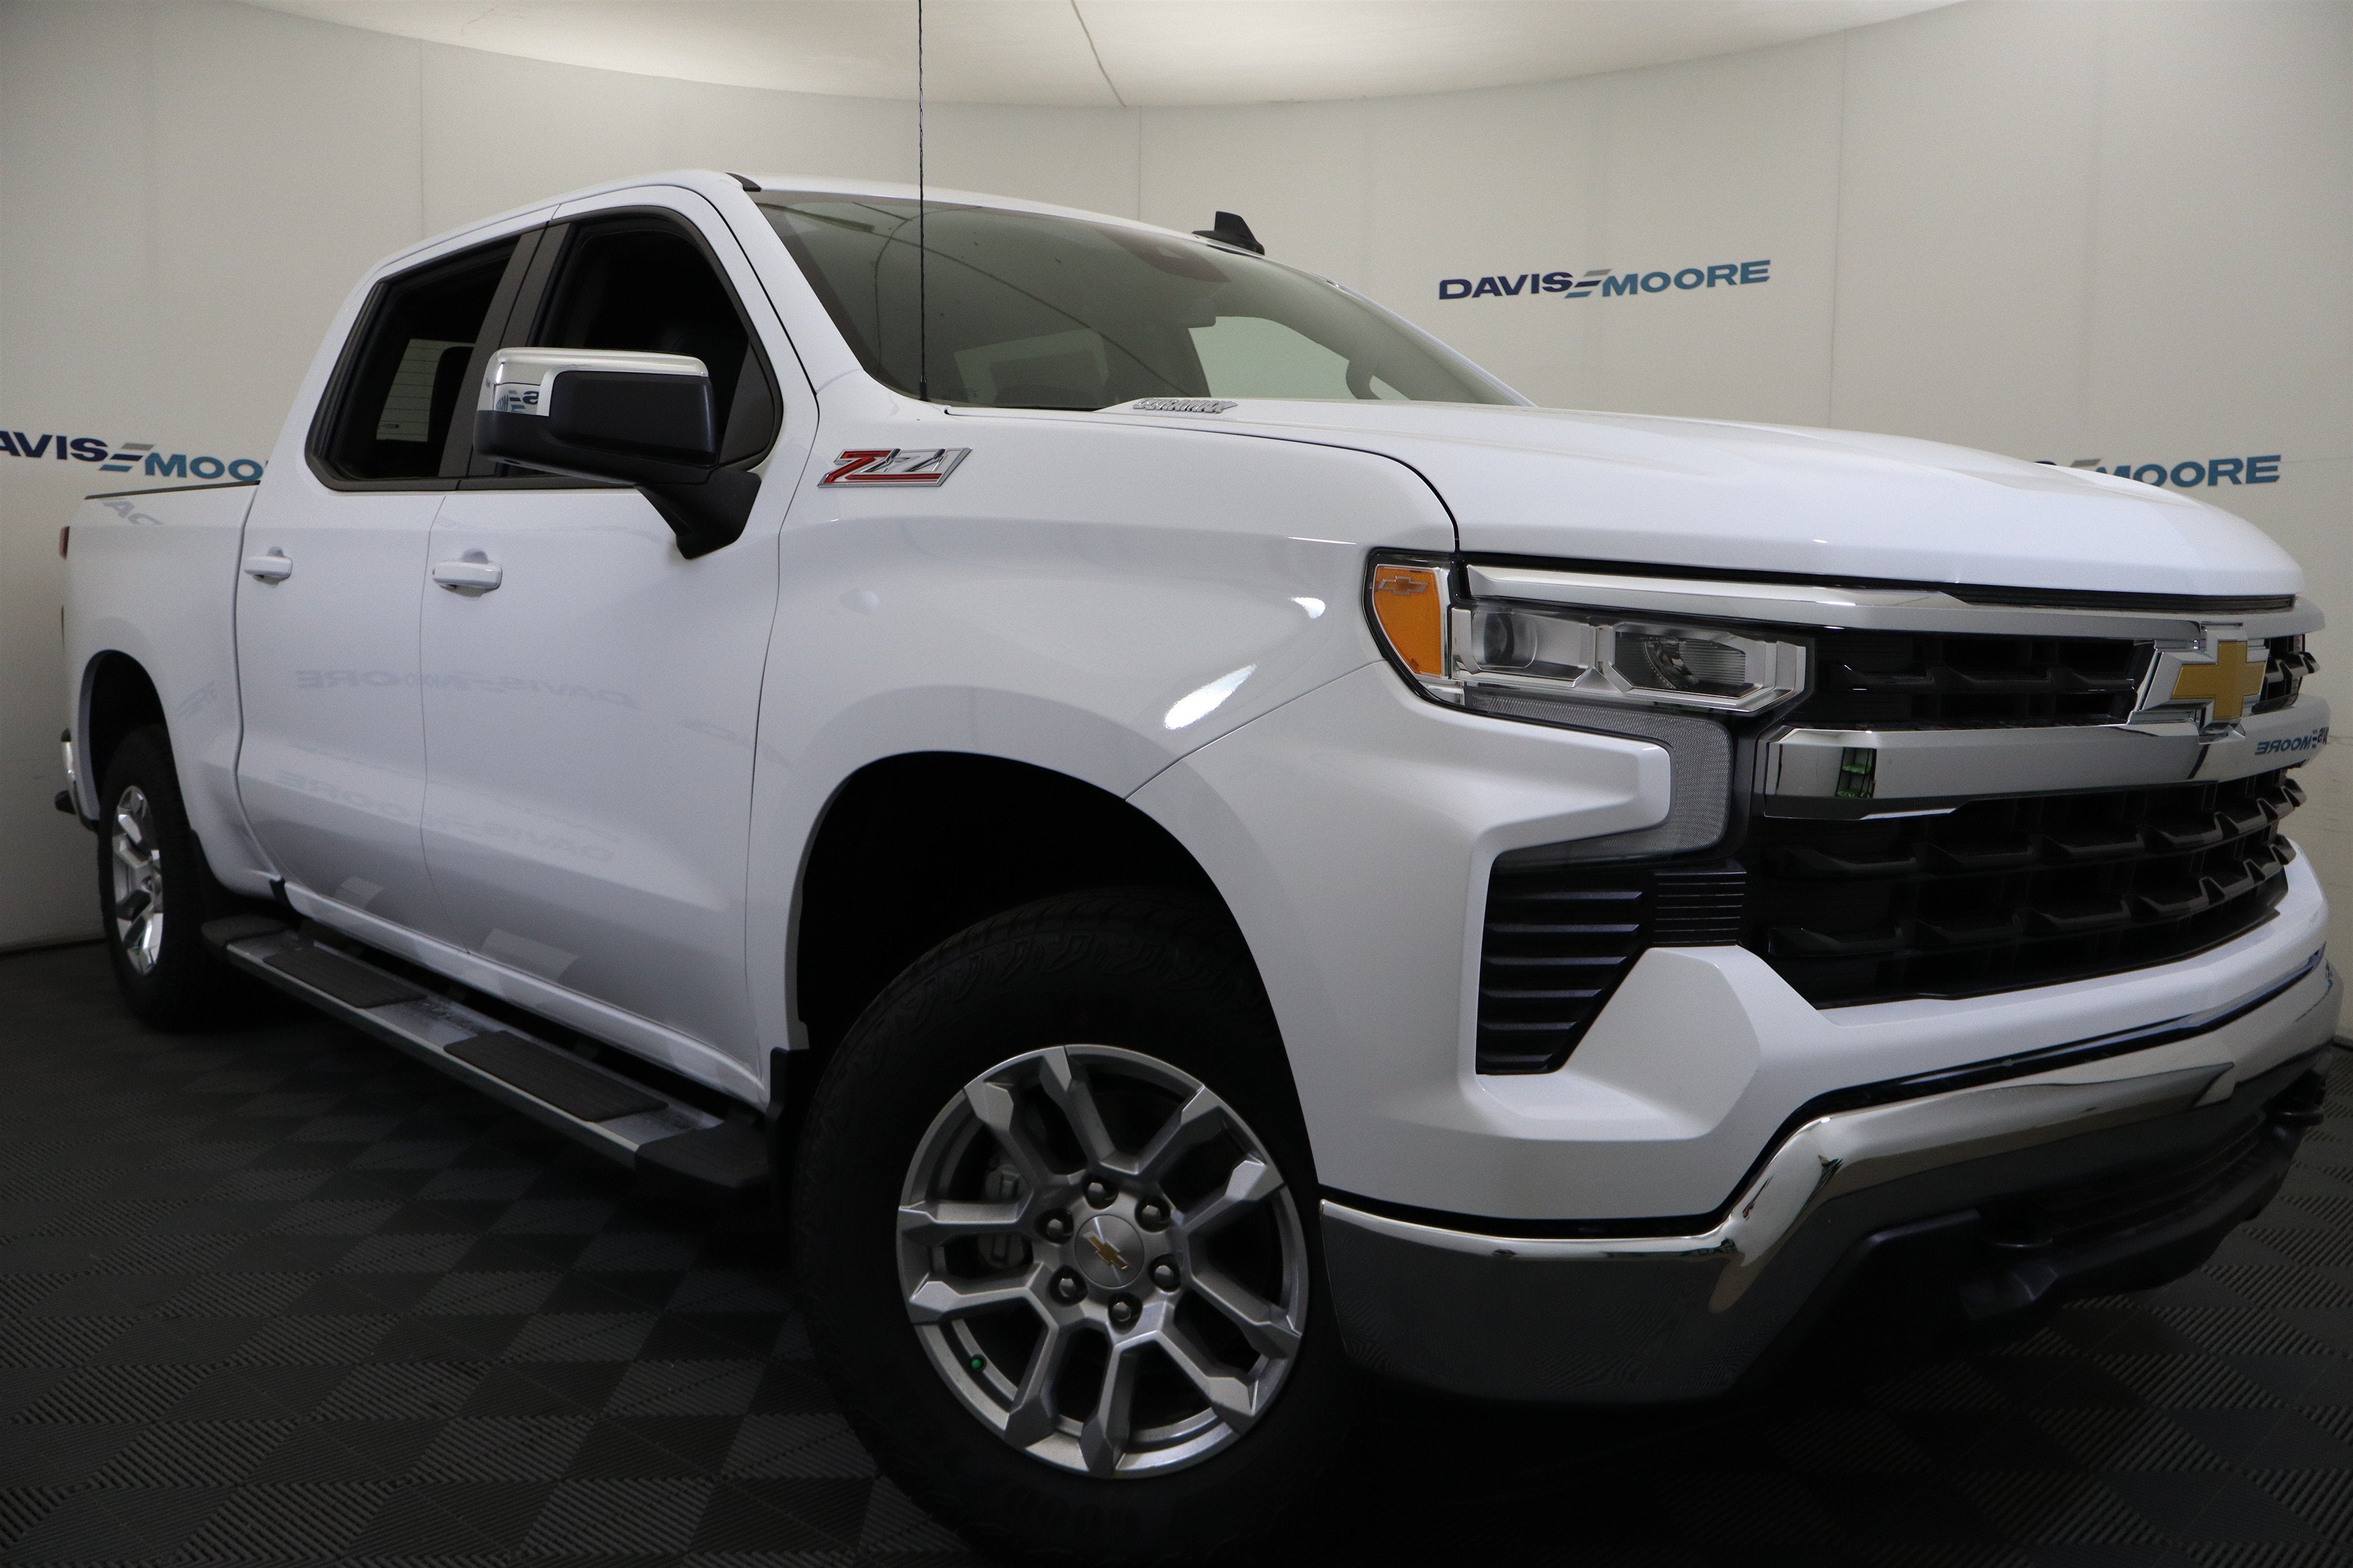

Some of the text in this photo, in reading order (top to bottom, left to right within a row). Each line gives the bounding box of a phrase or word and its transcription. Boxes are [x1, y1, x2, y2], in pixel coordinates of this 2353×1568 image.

[1438, 260, 1771, 300] DAVIS MOORE
[0, 430, 268, 481] AVIS MOO
[817, 447, 973, 488] Z71
